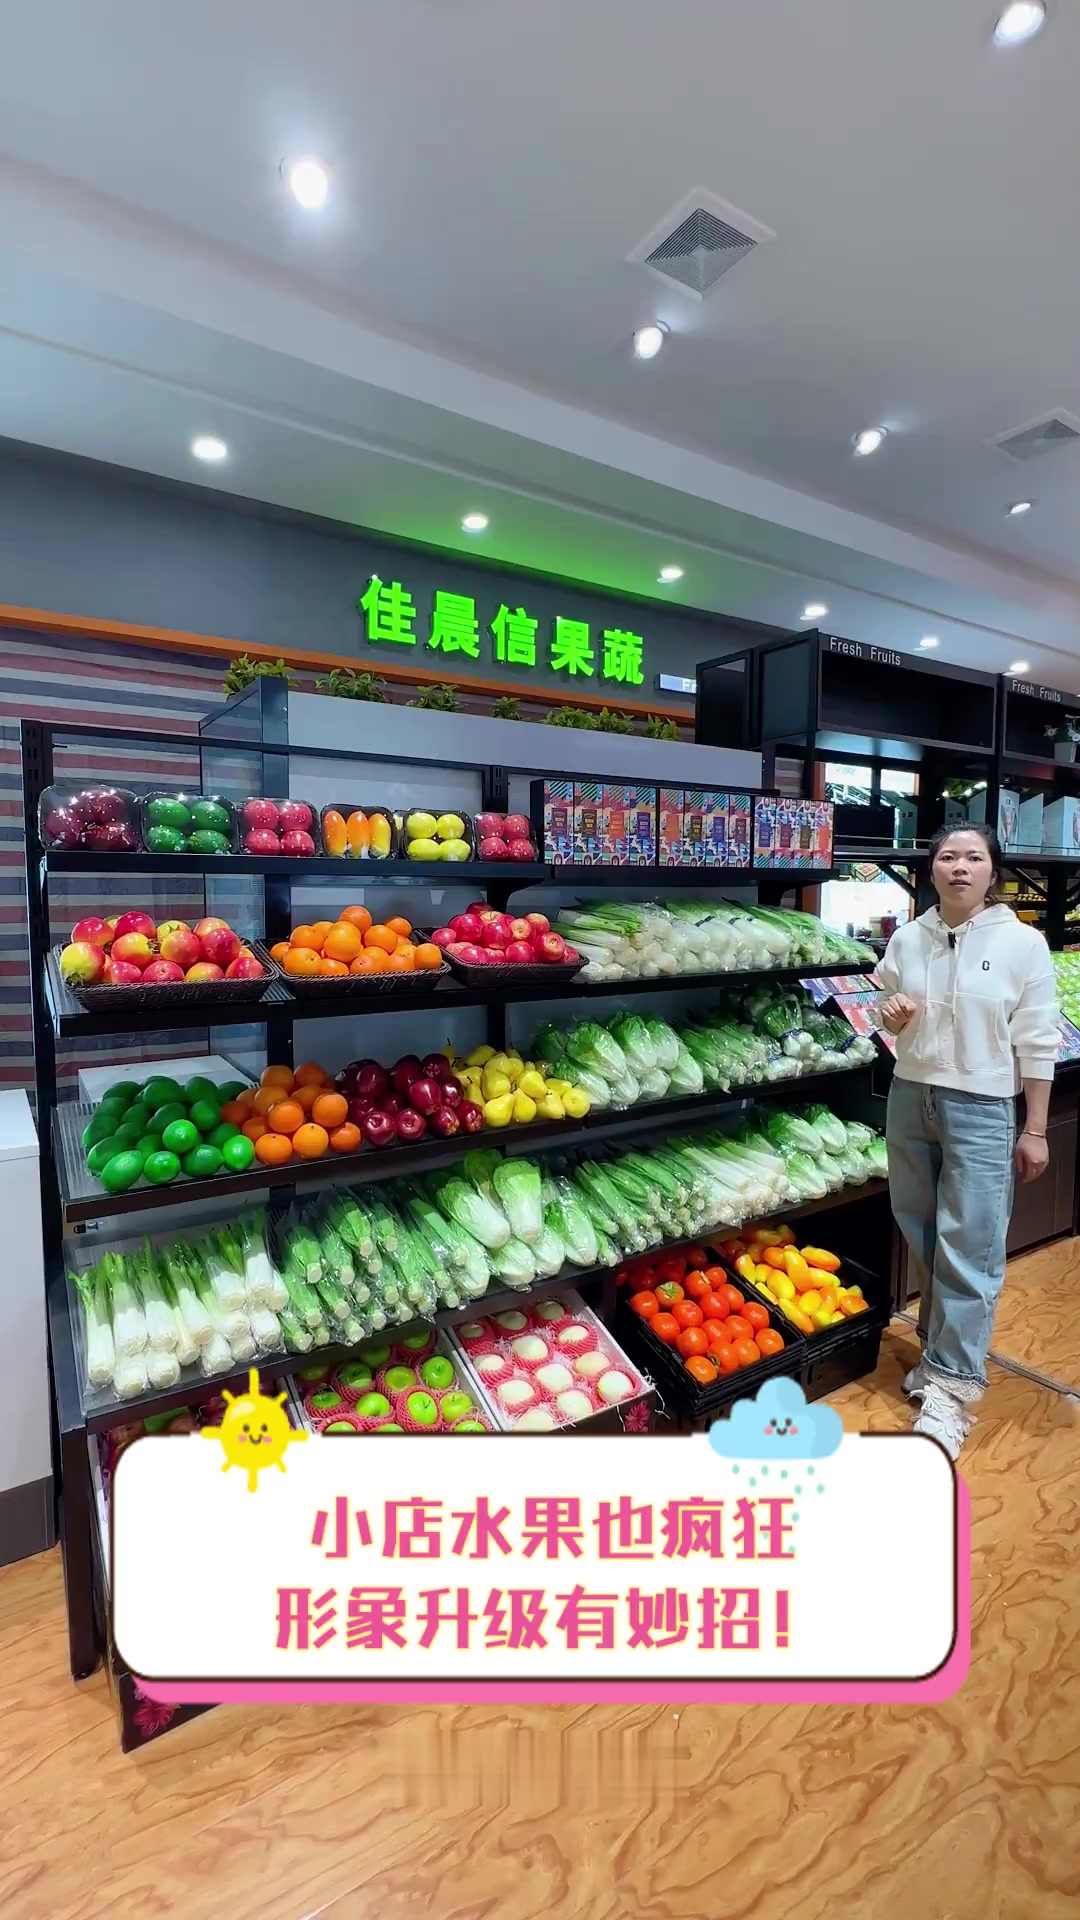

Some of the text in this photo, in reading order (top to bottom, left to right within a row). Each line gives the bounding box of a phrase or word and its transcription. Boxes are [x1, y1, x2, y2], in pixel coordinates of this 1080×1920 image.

[361, 578, 644, 686] 佳晨信果蔬
[829, 636, 901, 667] Fresh Fruits
[1011, 679, 1061, 703] Fresh Fruits
